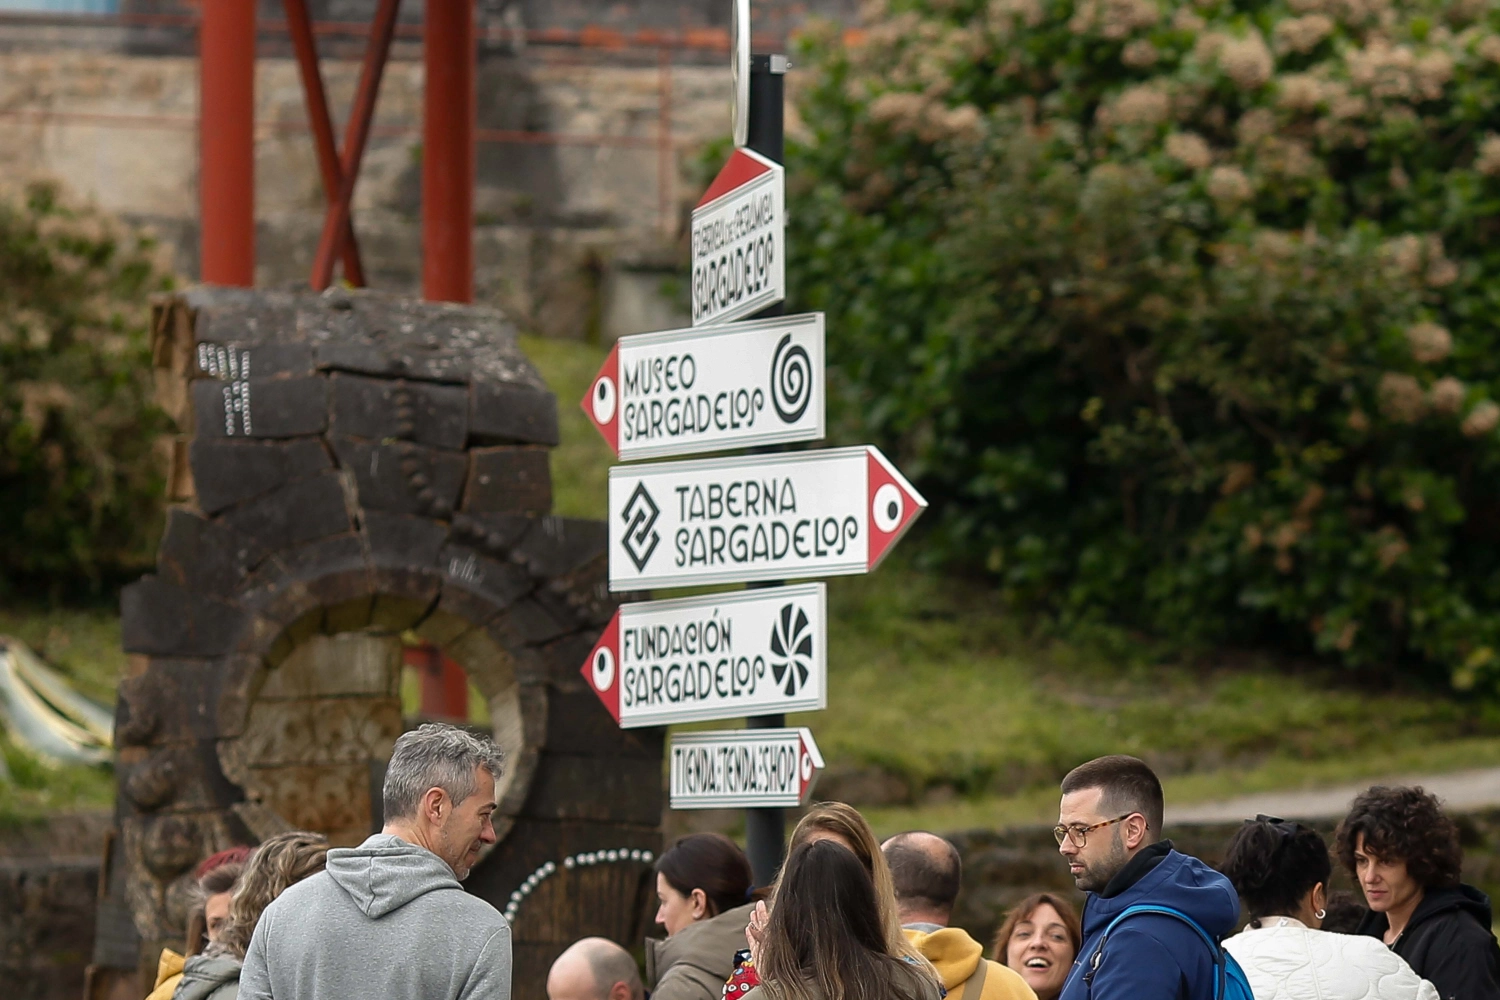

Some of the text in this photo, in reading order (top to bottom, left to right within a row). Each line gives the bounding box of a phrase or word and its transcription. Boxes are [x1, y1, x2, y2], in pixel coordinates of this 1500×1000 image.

[692, 232, 774, 320] SARGADELOS
[623, 354, 696, 398] MUSEO
[624, 387, 764, 441] SARGADELOS
[675, 476, 796, 522] TABERNA
[675, 515, 858, 567] SARGADELOS
[623, 607, 733, 662] FUNDACIÓN
[624, 654, 765, 708] SARGADELOS
